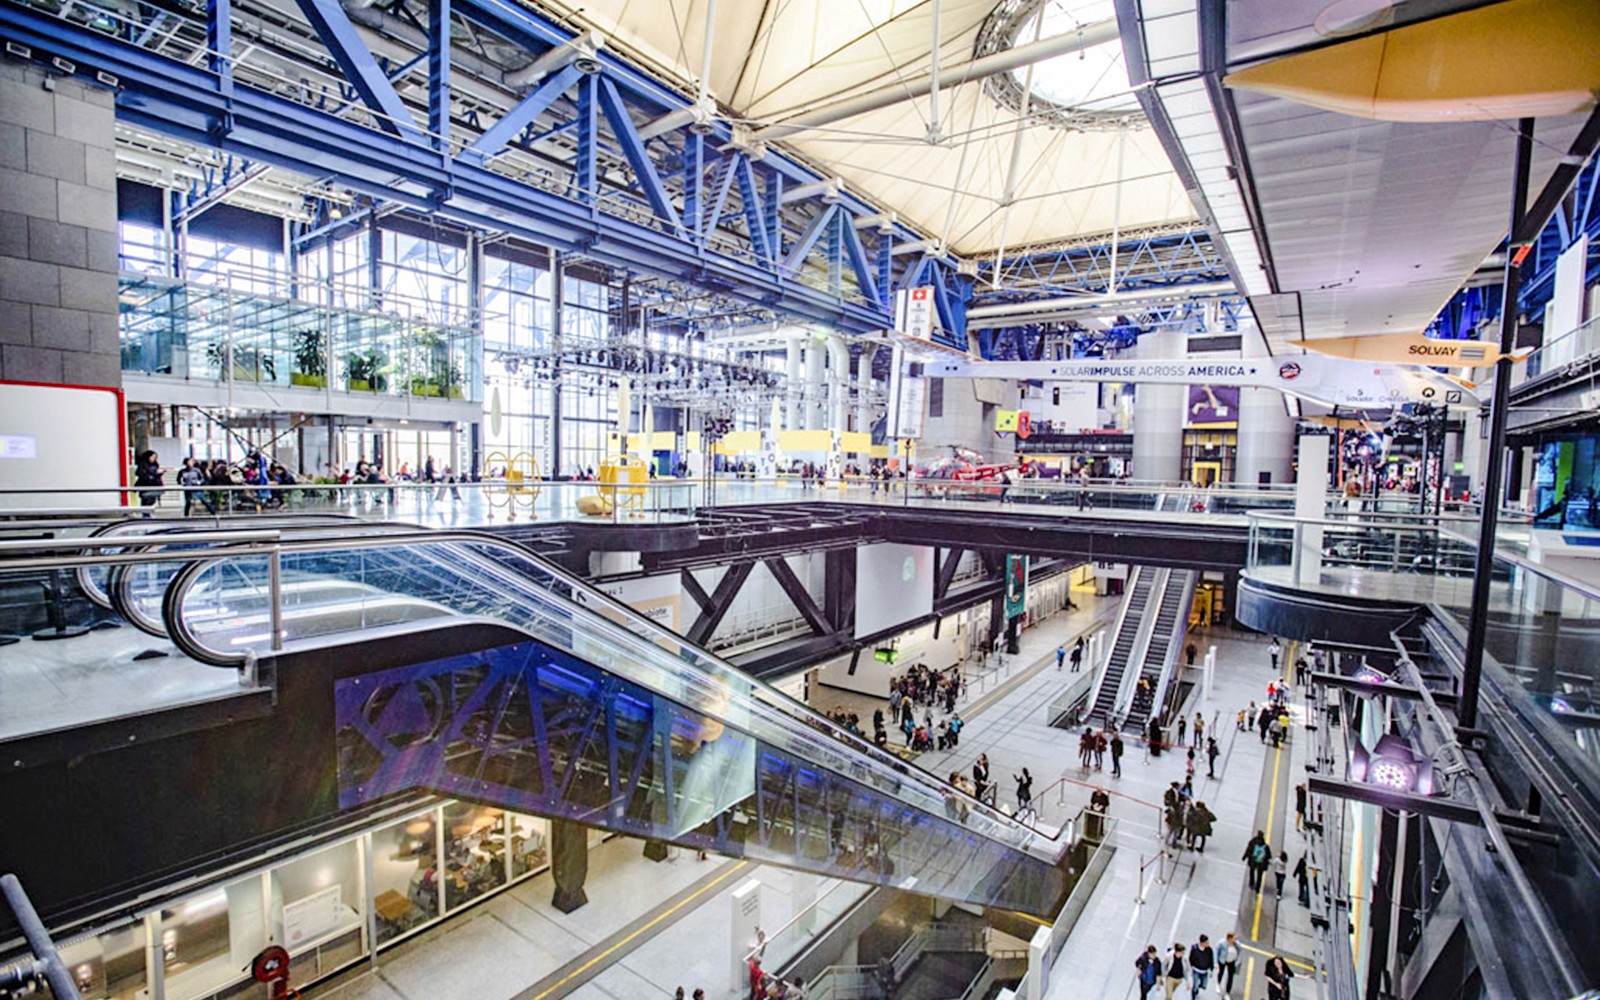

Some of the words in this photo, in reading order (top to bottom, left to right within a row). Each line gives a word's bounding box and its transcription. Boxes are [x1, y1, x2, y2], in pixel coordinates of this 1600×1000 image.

[1409, 345, 1457, 356] SOLVAY
[1059, 366, 1136, 377] SOLARIMPULSE
[1138, 366, 1185, 377] ACROSS
[1187, 366, 1245, 377] AMERICA
